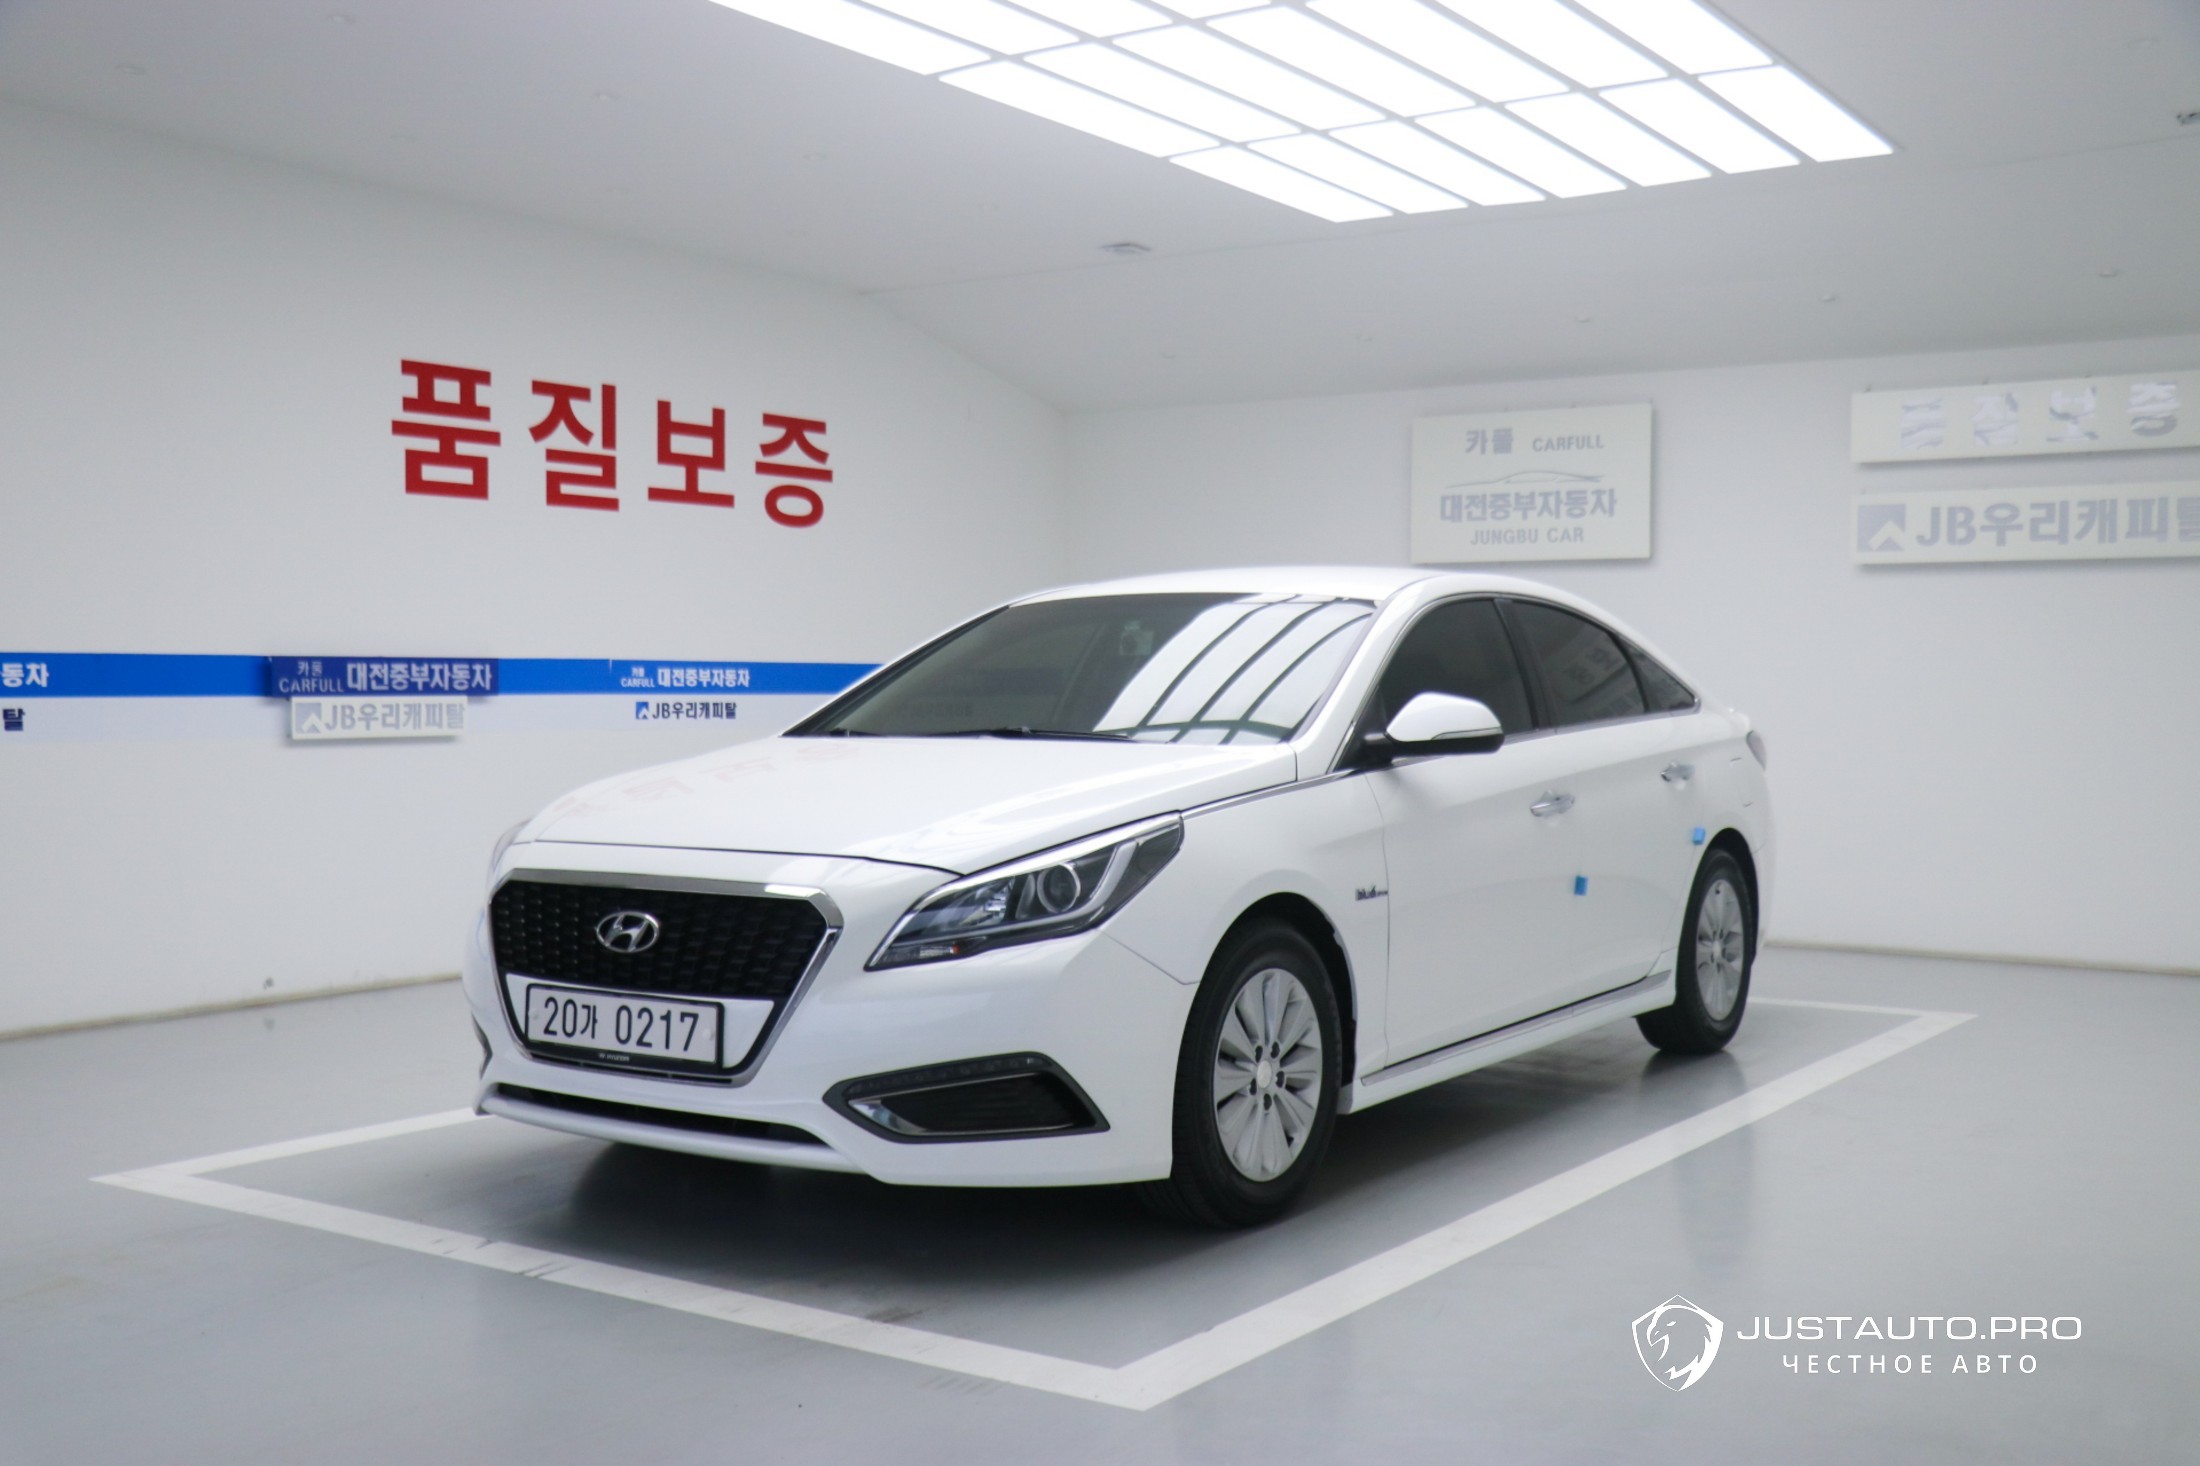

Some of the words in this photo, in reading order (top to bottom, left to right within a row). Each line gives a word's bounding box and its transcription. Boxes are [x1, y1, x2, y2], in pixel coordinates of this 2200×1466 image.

[392, 359, 833, 529] 품질보증
[1532, 434, 1605, 453] CARFULL
[1440, 489, 1618, 523] 대전중부자동차
[1470, 528, 1539, 546] JUNGBU
[1546, 527, 1584, 544] CAR
[279, 678, 344, 693] CARFULL
[346, 662, 492, 691] 대전중부자동차
[621, 678, 655, 688] CARFULL
[657, 667, 750, 688] 대전중부자동차
[325, 702, 465, 732] JB우리캐피탈
[652, 702, 737, 720] JB우리캐피탈
[543, 996, 599, 1040] 20가
[615, 1004, 700, 1052] 0217
